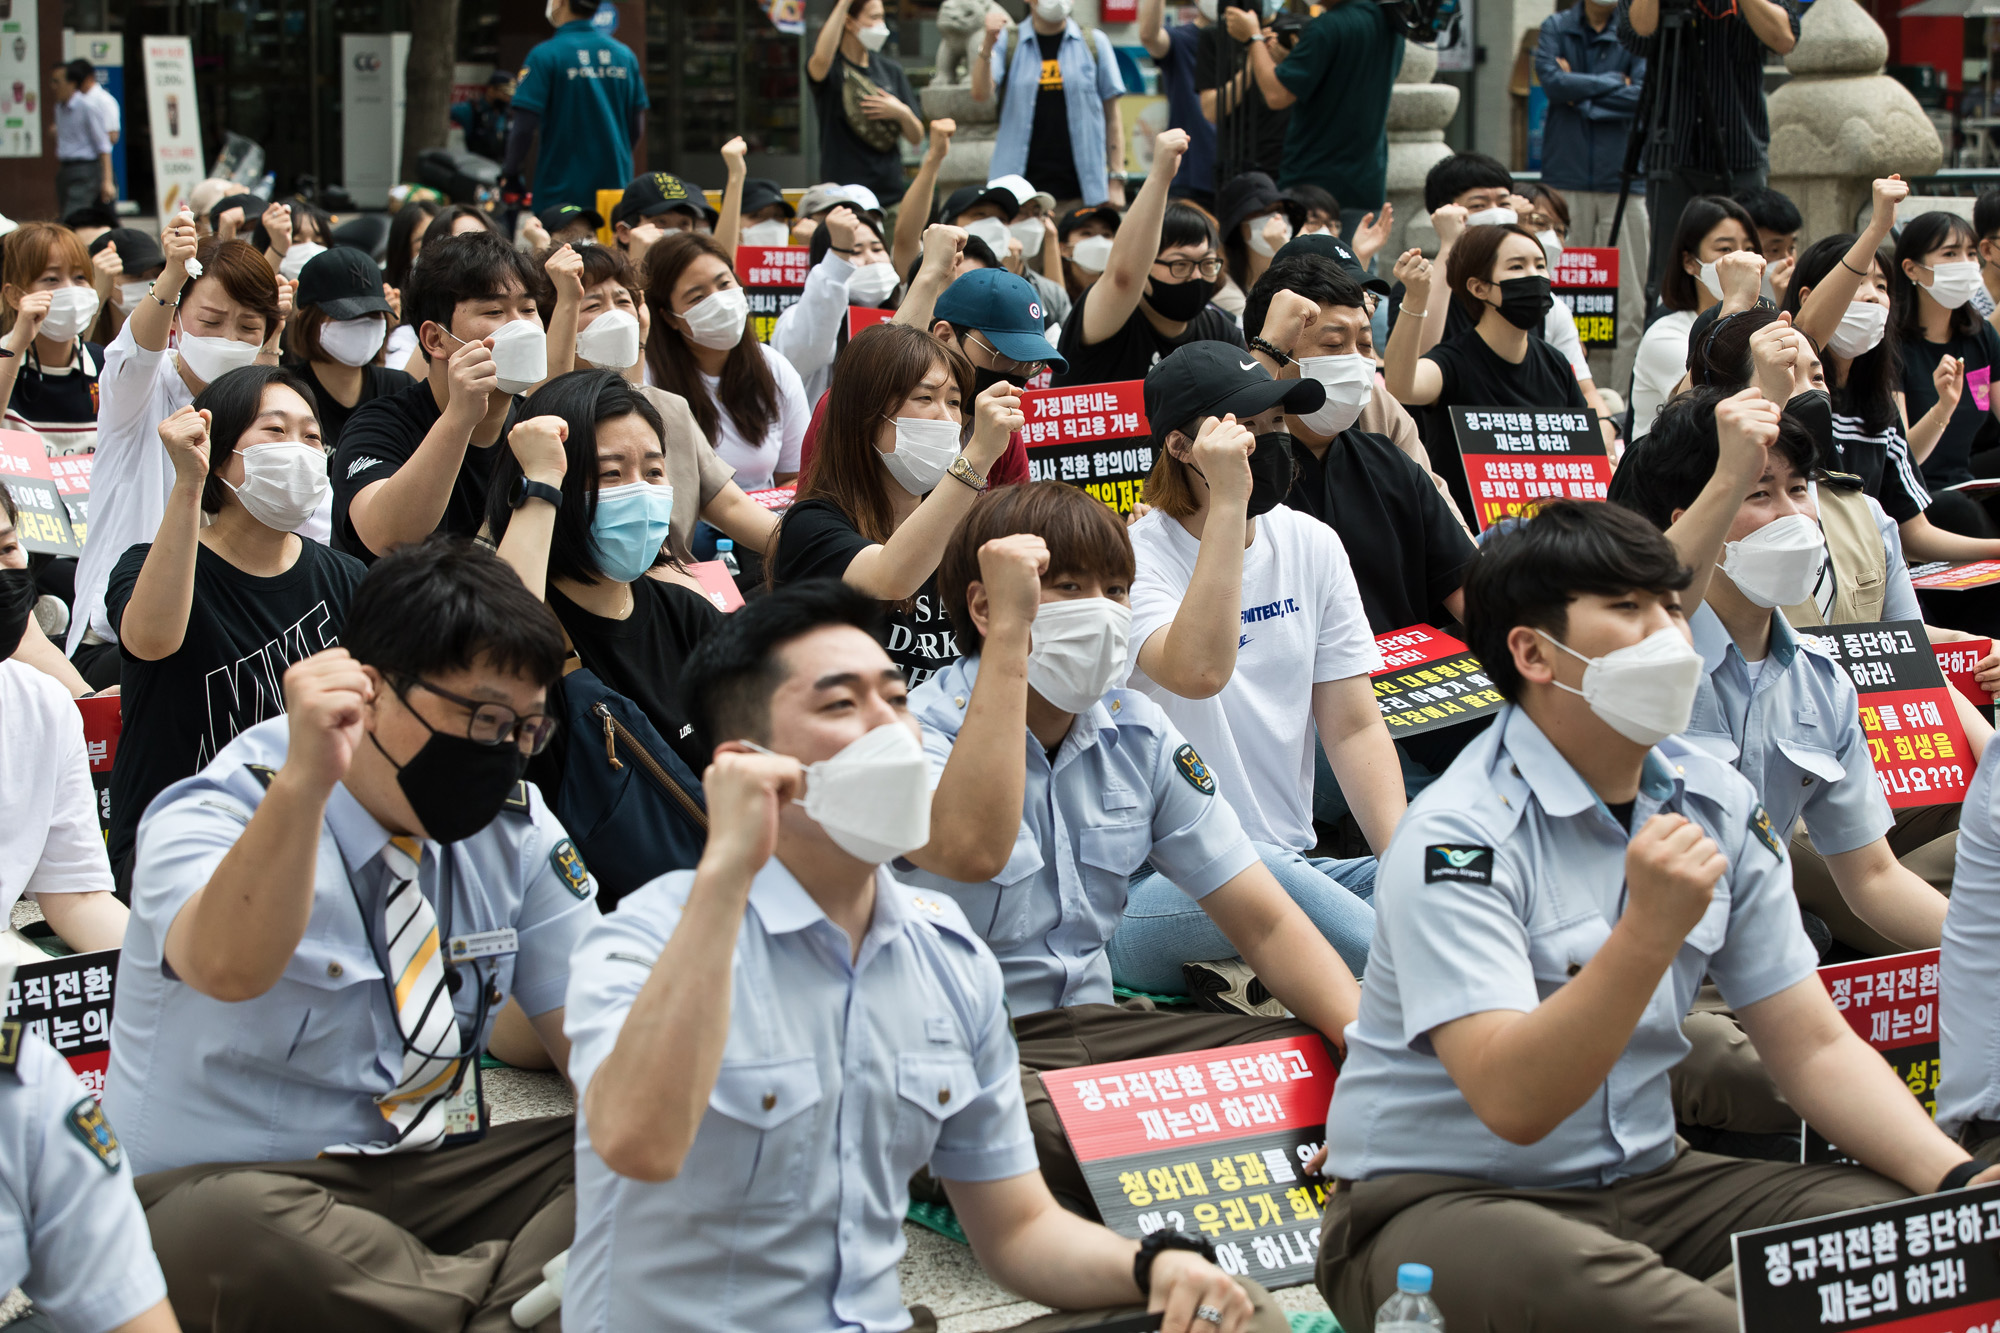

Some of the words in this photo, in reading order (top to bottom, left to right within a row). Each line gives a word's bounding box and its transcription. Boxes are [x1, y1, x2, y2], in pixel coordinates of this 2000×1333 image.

[567, 67, 627, 79] POLICE
[1557, 253, 1597, 268] 파탄내는
[749, 267, 782, 283] 일방적
[1577, 295, 1614, 313] 합의이행
[1033, 391, 1119, 418] 가정파탄내는
[1063, 415, 1107, 438] 직고용
[1110, 412, 1139, 433] 거부
[1465, 412, 1533, 431] 정규직전환
[1534, 414, 1590, 432] 중단하고
[1494, 433, 1536, 451] 재논의
[1537, 434, 1571, 452] 하라!
[1060, 454, 1090, 481] 전환
[1093, 447, 1153, 478] 합의이행
[1484, 462, 1537, 480] 인천공항
[1541, 462, 1595, 480] 찾아왔던
[1480, 481, 1520, 498] 문재인
[1524, 481, 1564, 498] 대통령
[1568, 482, 1608, 499] 때문에
[885, 623, 962, 659] DARK
[1843, 630, 1917, 658] 중단하고
[1850, 661, 1896, 686] 하라!
[1407, 680, 1472, 703] 아빠가
[1383, 701, 1467, 726] 직장에서
[1903, 701, 1944, 729] 위해
[1893, 732, 1956, 761] 희생을
[1831, 963, 1940, 1011] 정규직전환
[1869, 1003, 1933, 1042] 재논의
[1072, 1064, 1208, 1112] 정규직전환
[1206, 1049, 1314, 1092] 중단하고
[1136, 1103, 1221, 1141] 재논의
[1219, 1093, 1287, 1128] 하라!
[1117, 1161, 1210, 1207] 청와대
[1210, 1148, 1298, 1192] 성과를
[1193, 1192, 1284, 1238] 우리가
[1764, 1220, 1899, 1287] 정규직전환
[1904, 1199, 2000, 1258] 중단하고
[1817, 1270, 1899, 1325] 재논의
[1903, 1258, 1968, 1305] 하라!
